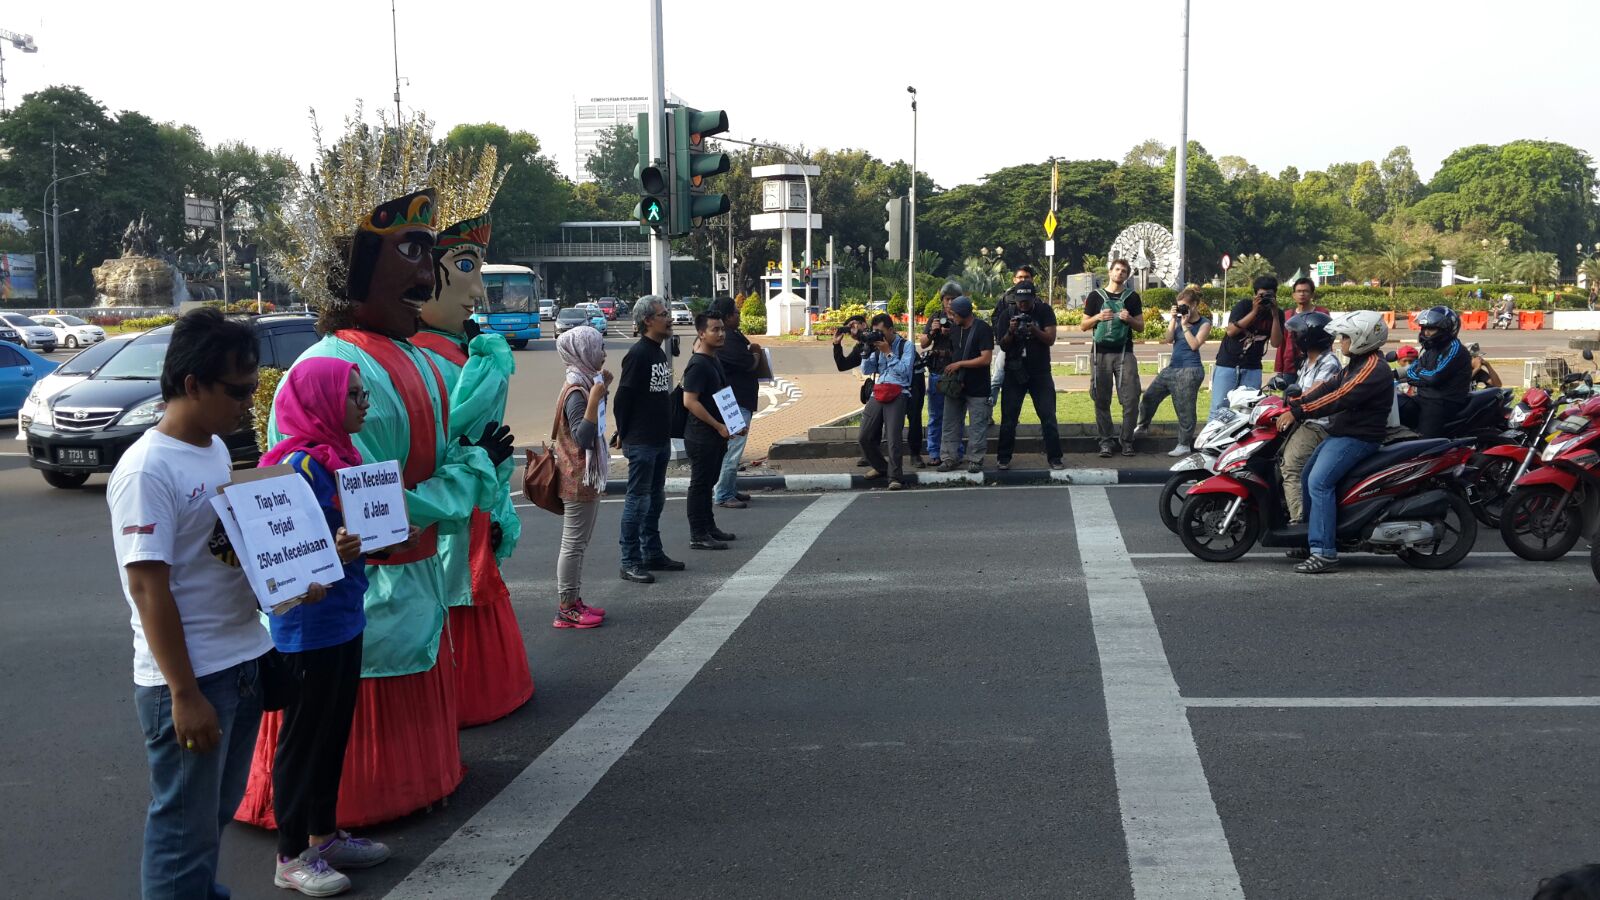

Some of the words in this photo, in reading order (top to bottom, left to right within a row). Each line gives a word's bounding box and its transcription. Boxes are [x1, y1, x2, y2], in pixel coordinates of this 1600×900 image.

[342, 473, 362, 494] Cegah
[361, 469, 399, 488] Kecelakaan
[255, 493, 273, 511] Tiap
[272, 490, 291, 506] hari,
[364, 502, 370, 519] di
[371, 500, 389, 518] Jalan
[268, 516, 295, 536] Terjadi
[257, 551, 284, 569] 250-an
[282, 538, 328, 561] Kecelakaan
